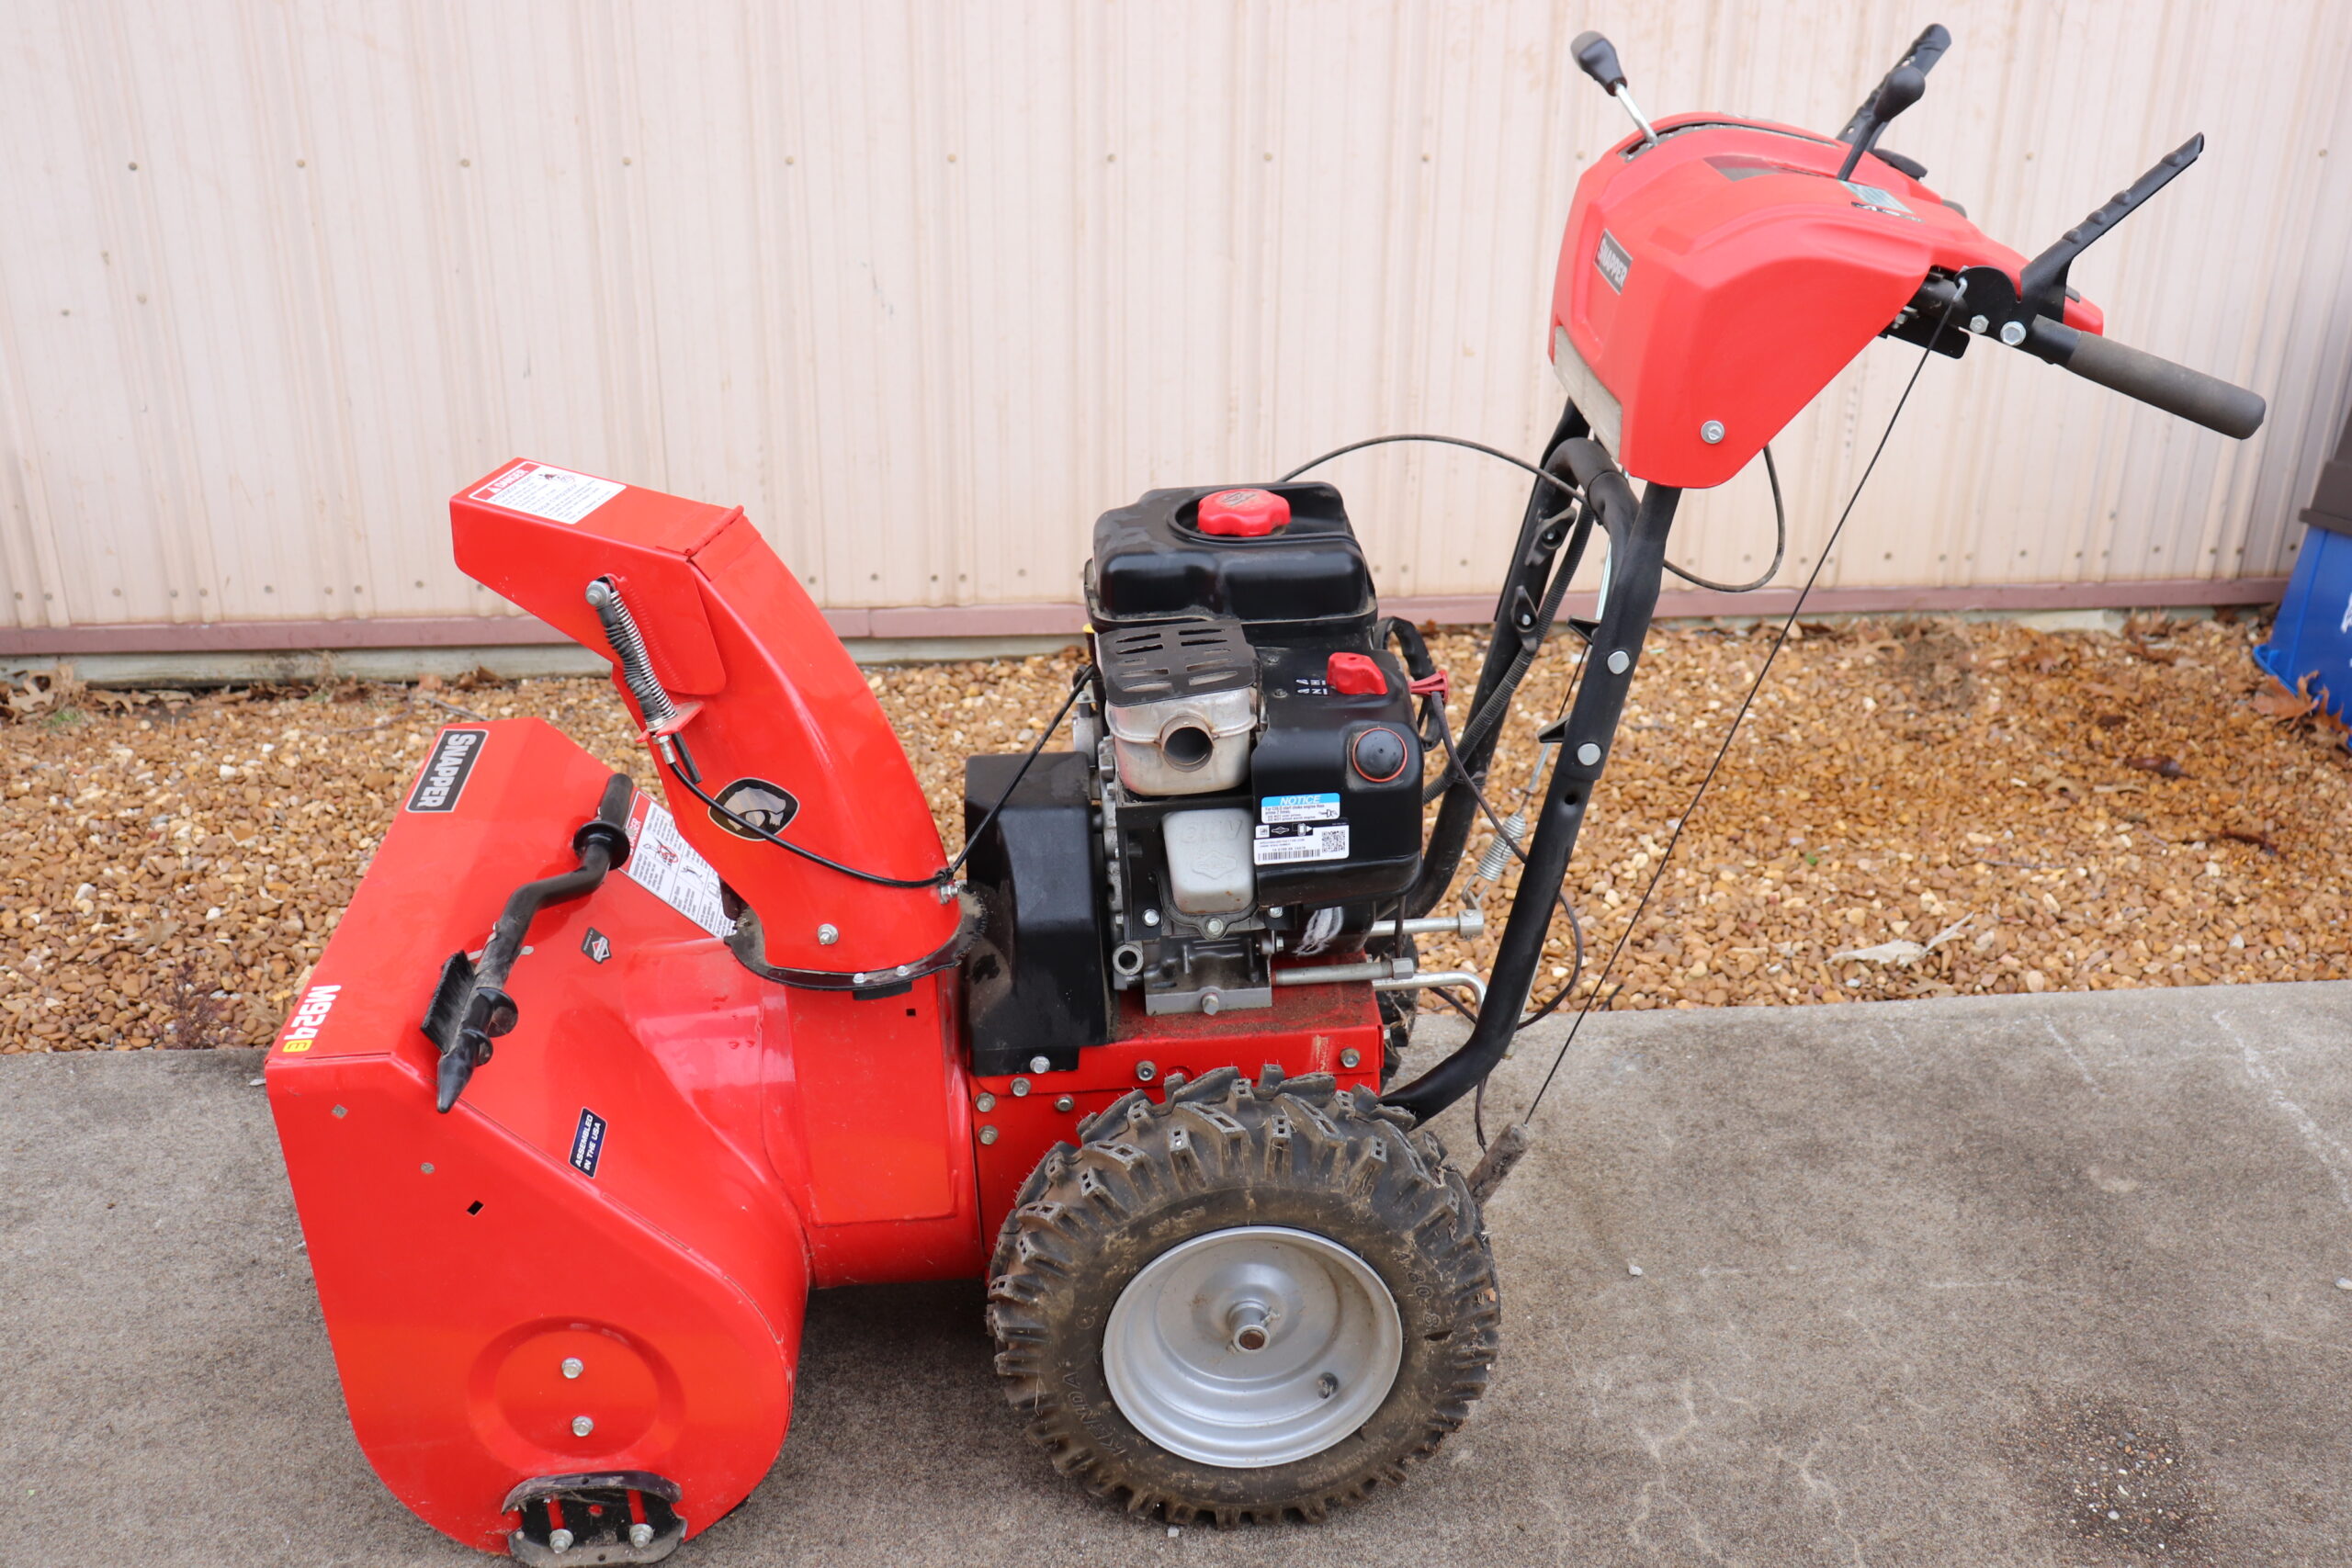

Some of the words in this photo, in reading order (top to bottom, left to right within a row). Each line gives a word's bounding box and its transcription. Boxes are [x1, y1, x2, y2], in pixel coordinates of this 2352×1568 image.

[493, 468, 530, 488] DANGER
[416, 733, 477, 807] SNAPPER
[1280, 795, 1321, 807] NOTICE
[575, 1114, 594, 1168] ASSEMBLED
[591, 1122, 602, 1141] USA
[586, 1141, 596, 1158] THE
[583, 1159, 593, 1171] IN
[1062, 1371, 1128, 1456] KENDA
